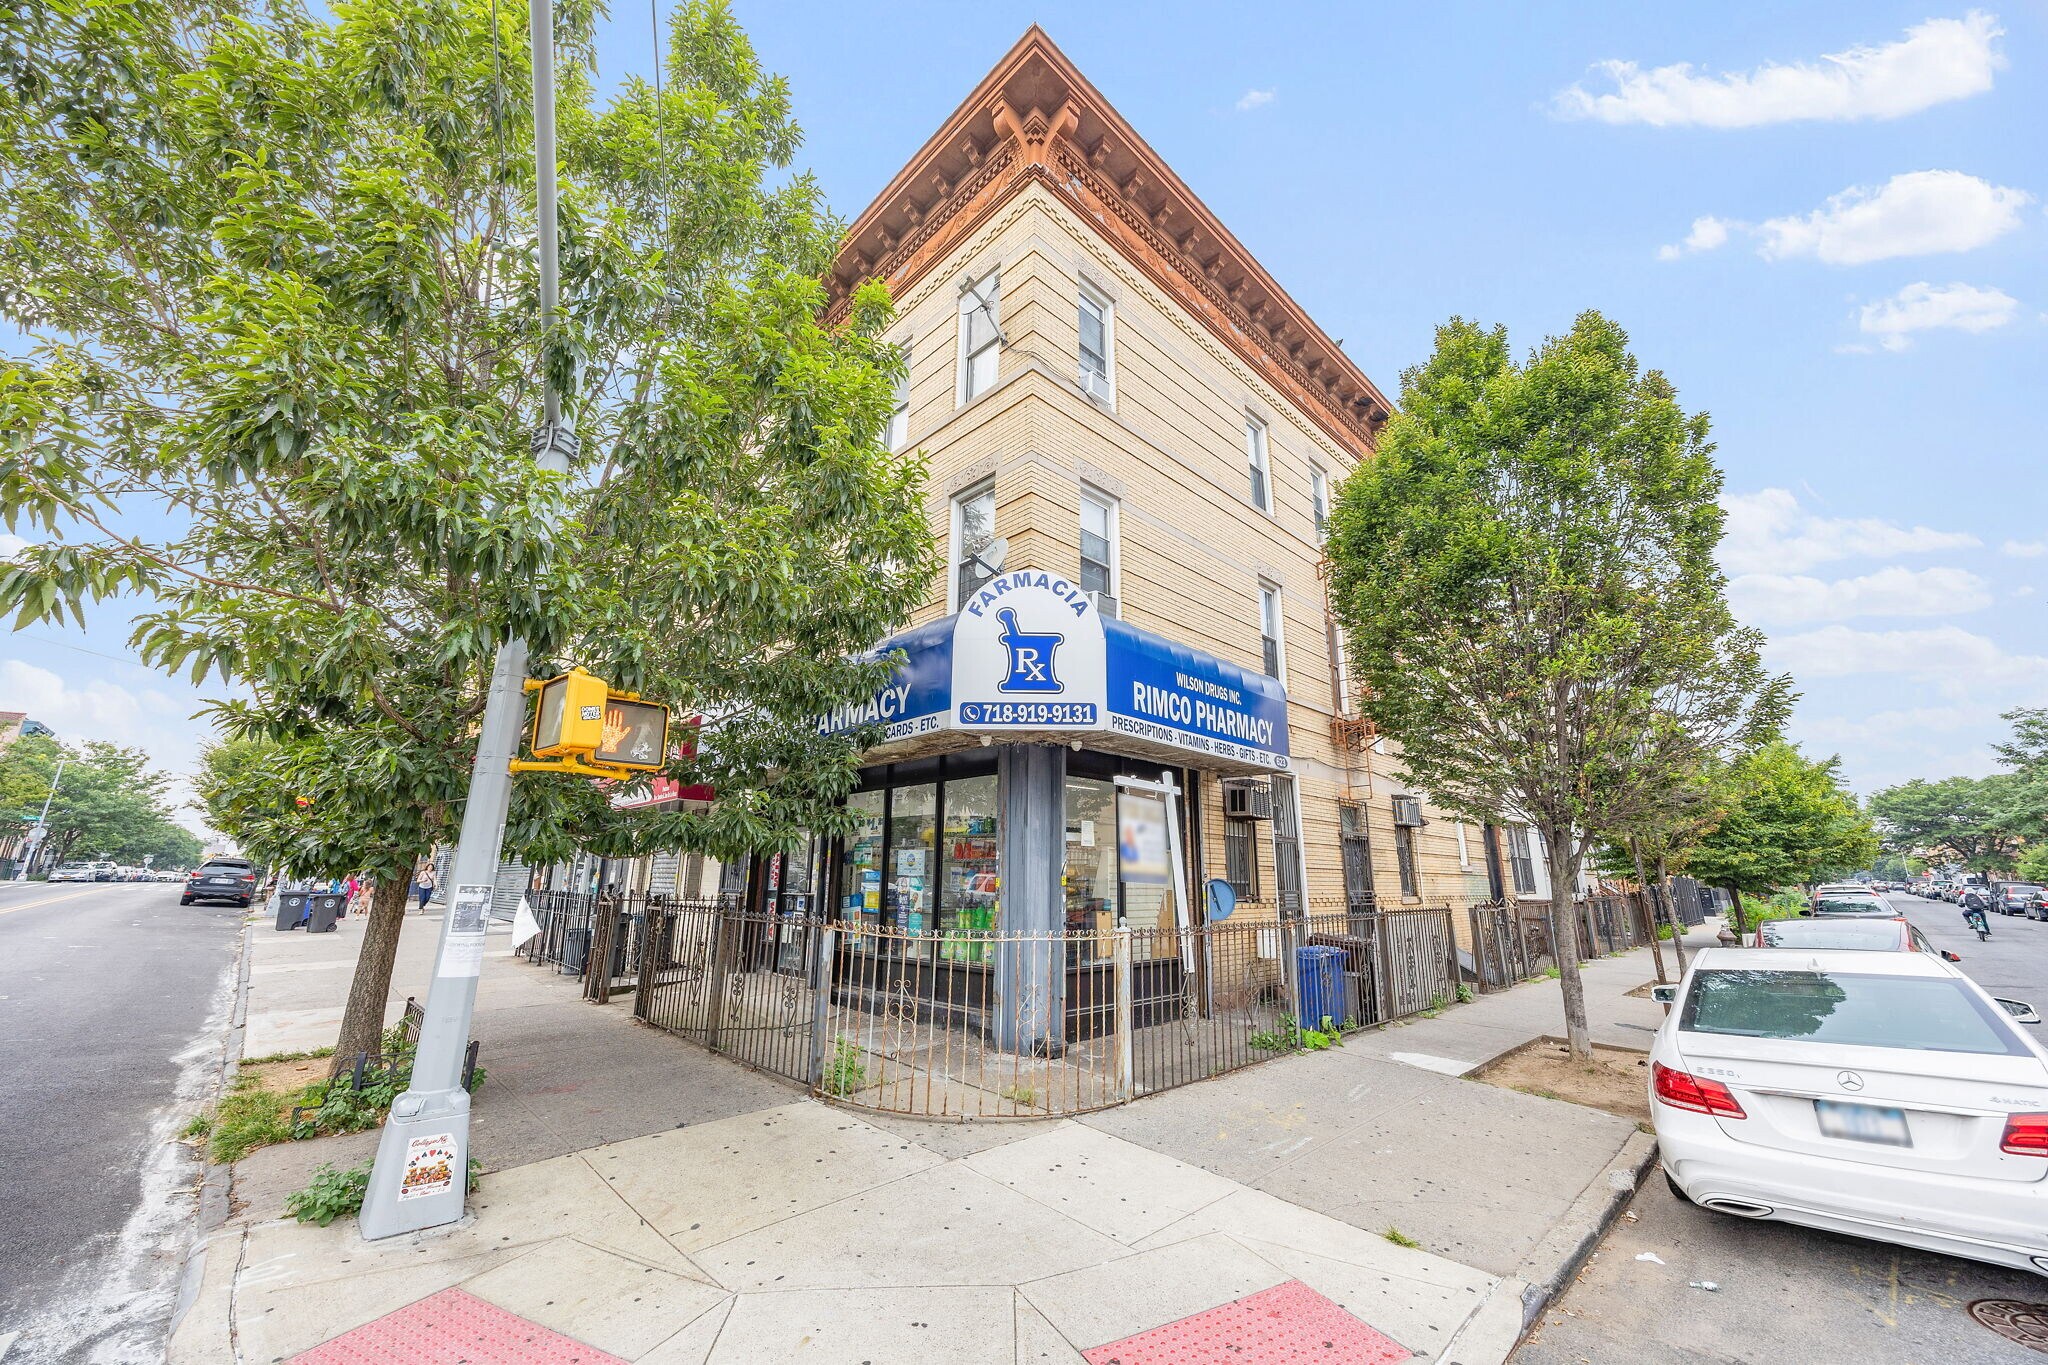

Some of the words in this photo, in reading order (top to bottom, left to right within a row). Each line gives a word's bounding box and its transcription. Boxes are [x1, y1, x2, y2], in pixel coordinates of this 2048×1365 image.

[968, 572, 1089, 618] FARMACIA
[1015, 648, 1047, 681] Rx
[1176, 671, 1204, 694] WILSON
[1205, 681, 1228, 701] DRUGS
[1228, 689, 1242, 706] INC.
[886, 722, 914, 739] CARDS
[920, 715, 939, 736] ETC.
[982, 704, 1094, 723] 718-919-9131
[1133, 680, 1192, 725] RIMCO
[1196, 700, 1274, 746] PHARMACY
[1112, 715, 1173, 743] PRESCRIPTIONS
[1178, 732, 1210, 752] VITAMINS
[1214, 742, 1235, 757] HERBS
[1239, 747, 1256, 762] GIFTS
[1259, 752, 1272, 765] ETC.
